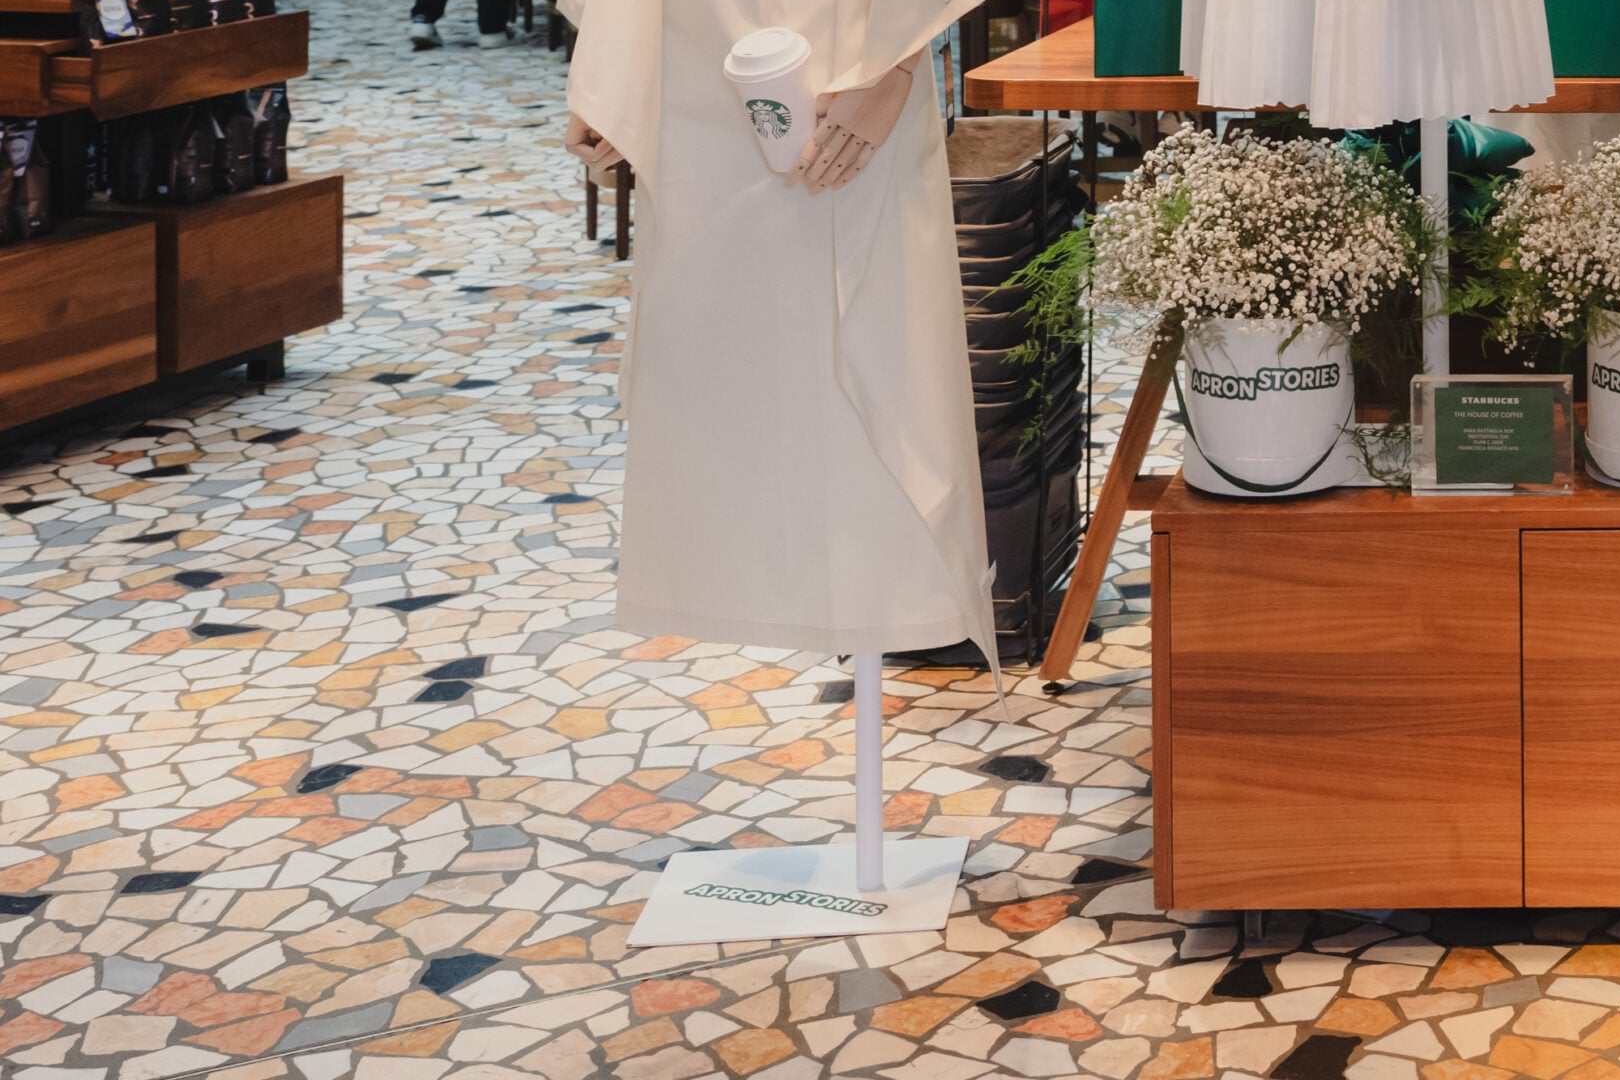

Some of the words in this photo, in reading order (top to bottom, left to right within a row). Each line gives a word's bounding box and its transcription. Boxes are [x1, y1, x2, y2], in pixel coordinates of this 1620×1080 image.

[1192, 370, 1255, 399] APRON
[1257, 365, 1339, 390] STORIES
[1461, 396, 1520, 405] STARBUCKS
[1500, 411, 1524, 419] COFFEE
[686, 884, 783, 905] APRON
[784, 891, 887, 916] STORIES
